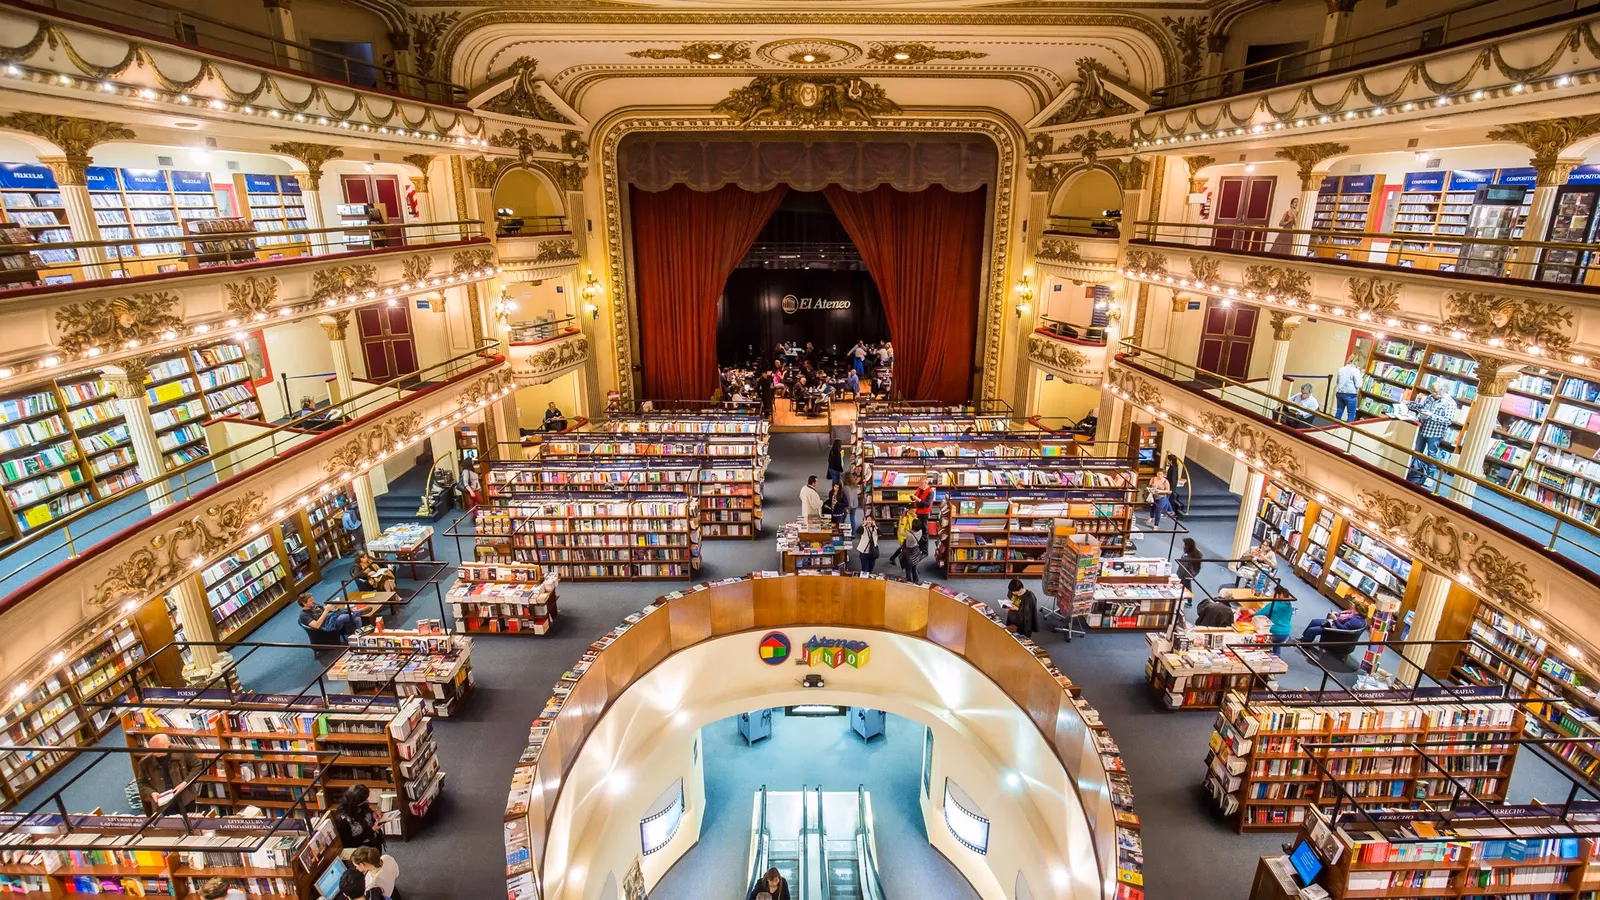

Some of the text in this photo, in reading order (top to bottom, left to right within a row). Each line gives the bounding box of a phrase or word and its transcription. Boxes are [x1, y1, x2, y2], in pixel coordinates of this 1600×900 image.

[799, 298, 851, 310] El Ateneo
[806, 634, 868, 650] Ateneo
[803, 649, 870, 666] Junior
